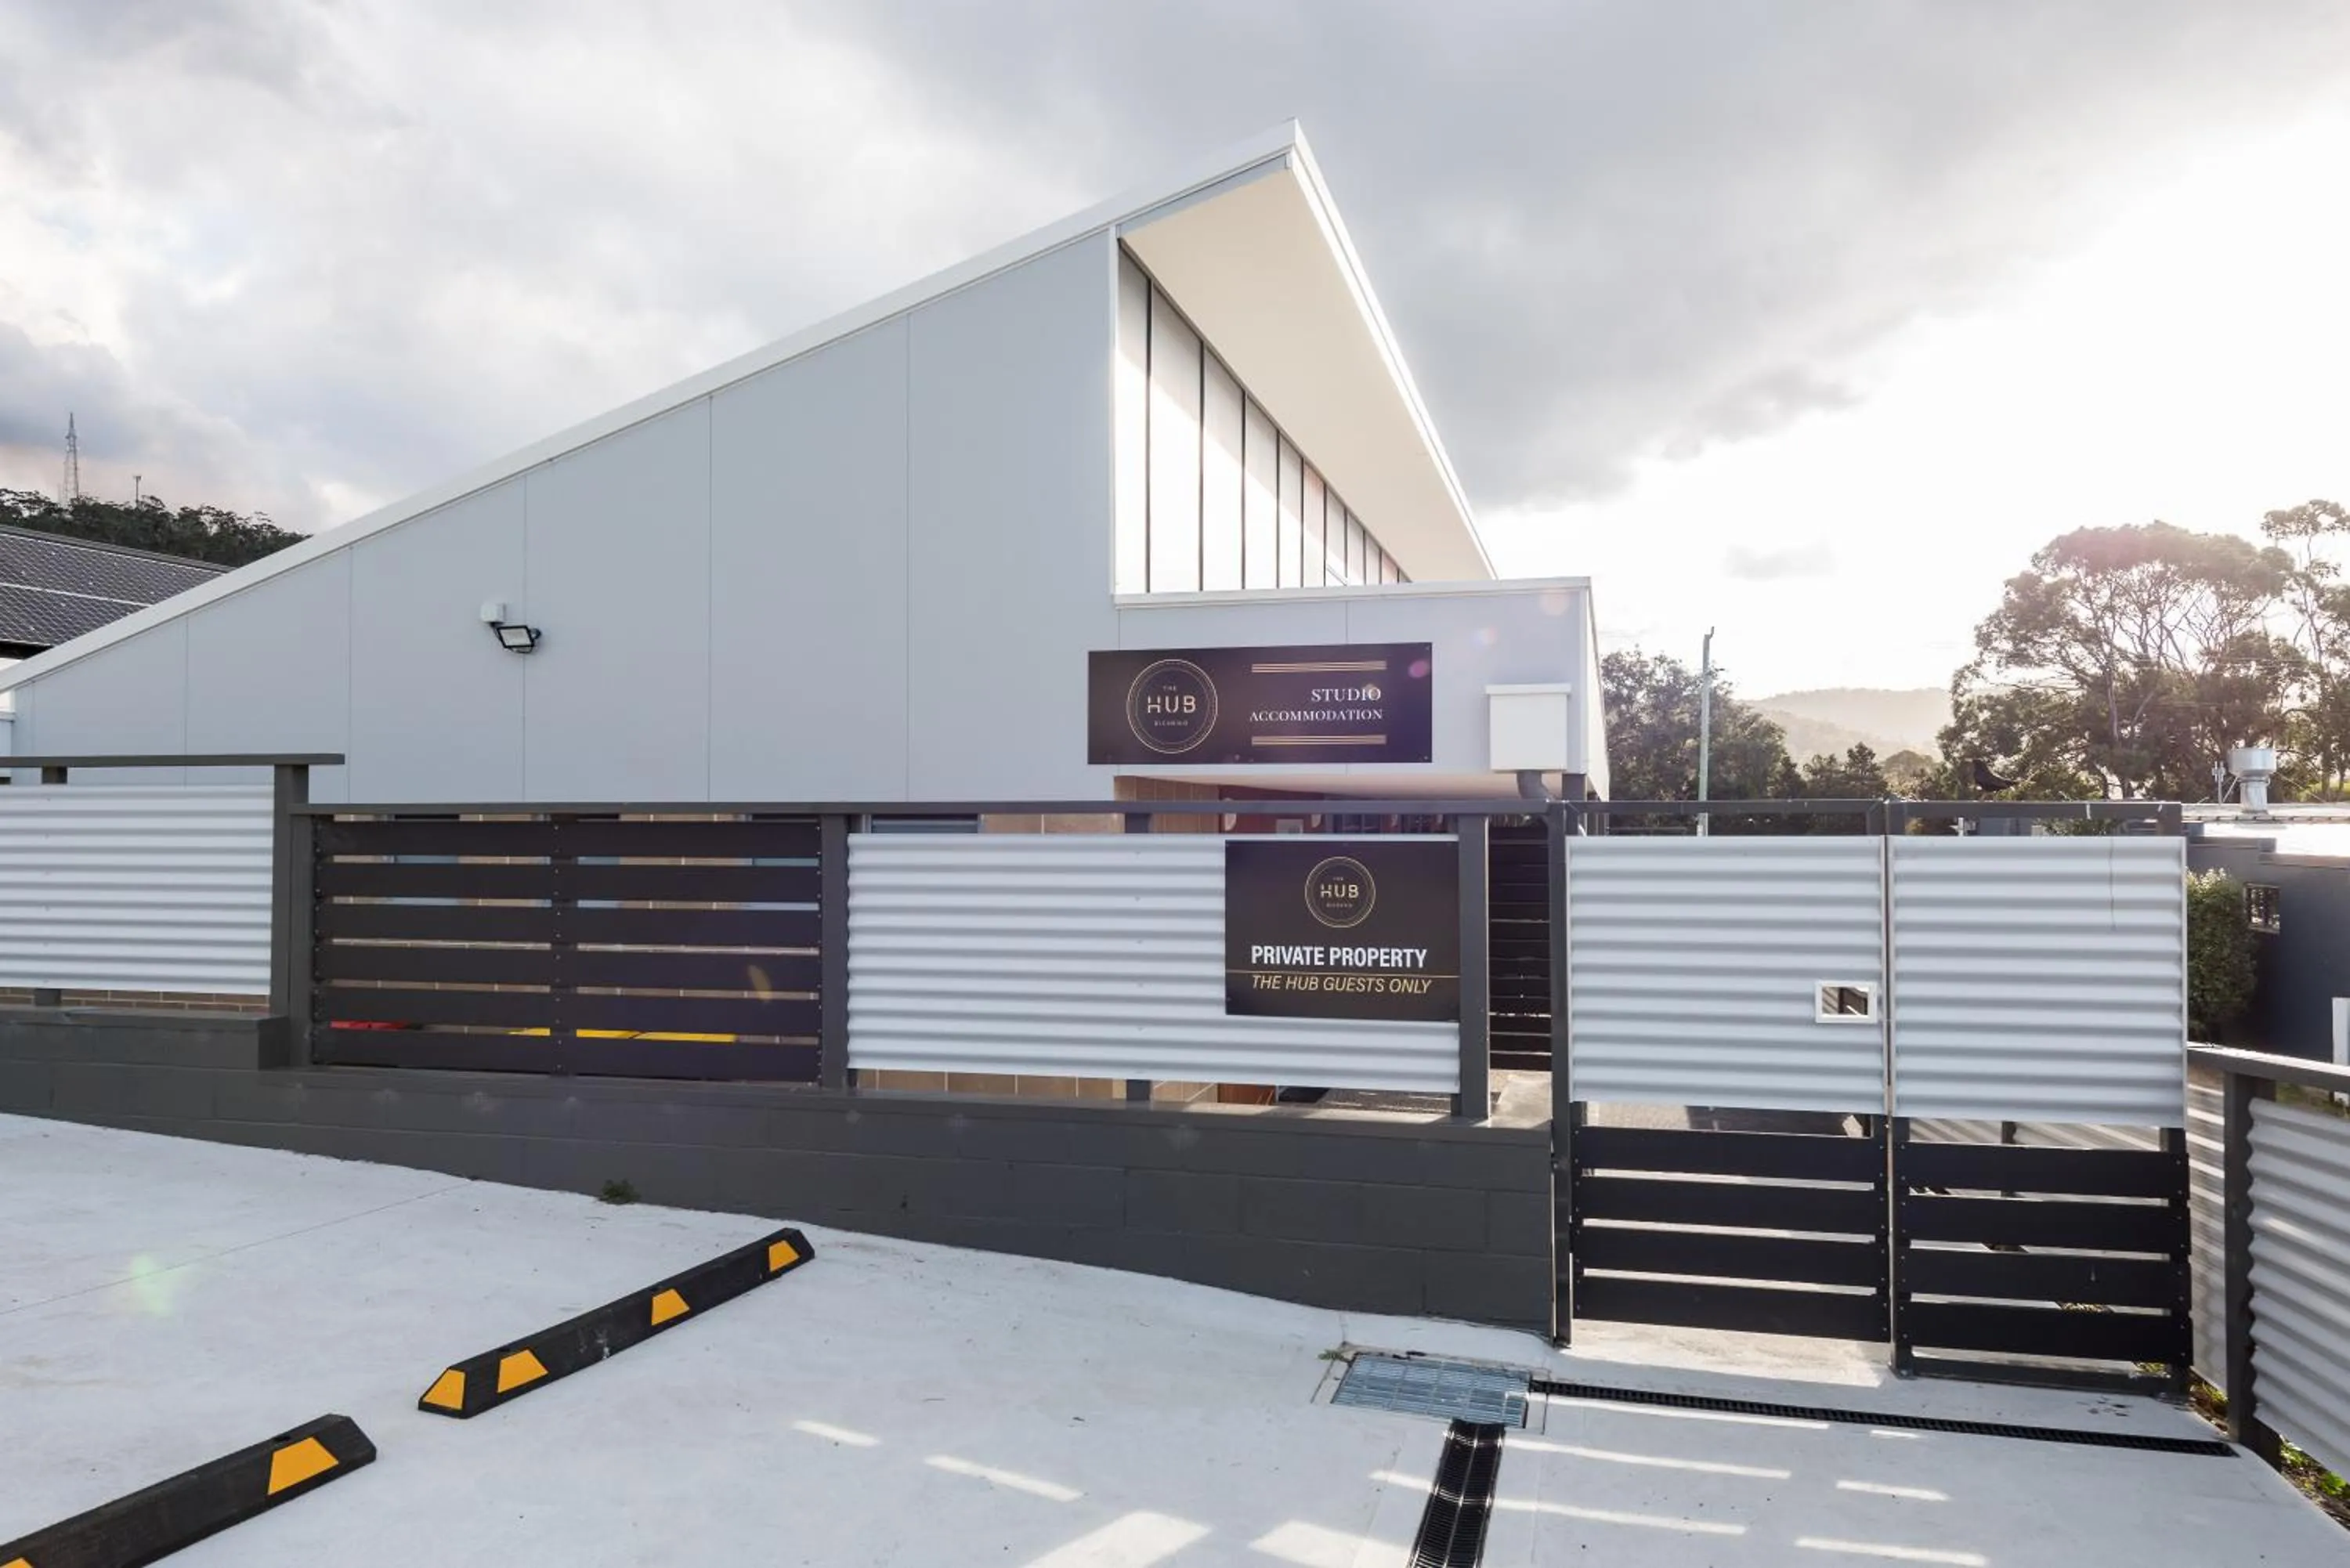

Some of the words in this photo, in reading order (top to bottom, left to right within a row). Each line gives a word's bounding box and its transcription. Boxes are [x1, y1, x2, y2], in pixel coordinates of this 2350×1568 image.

[1311, 688, 1381, 702] STUDIO
[1148, 695, 1196, 714] HUB
[1249, 709, 1383, 721] ACCOMMODATION
[1320, 883, 1359, 898] HUB
[1251, 945, 1325, 966] PRIVATE
[1329, 946, 1427, 968] PROPERTY
[1253, 974, 1282, 989] THE
[1285, 976, 1319, 991] HUB
[1323, 977, 1385, 992] GUESTS
[1389, 978, 1432, 994] ONLY
